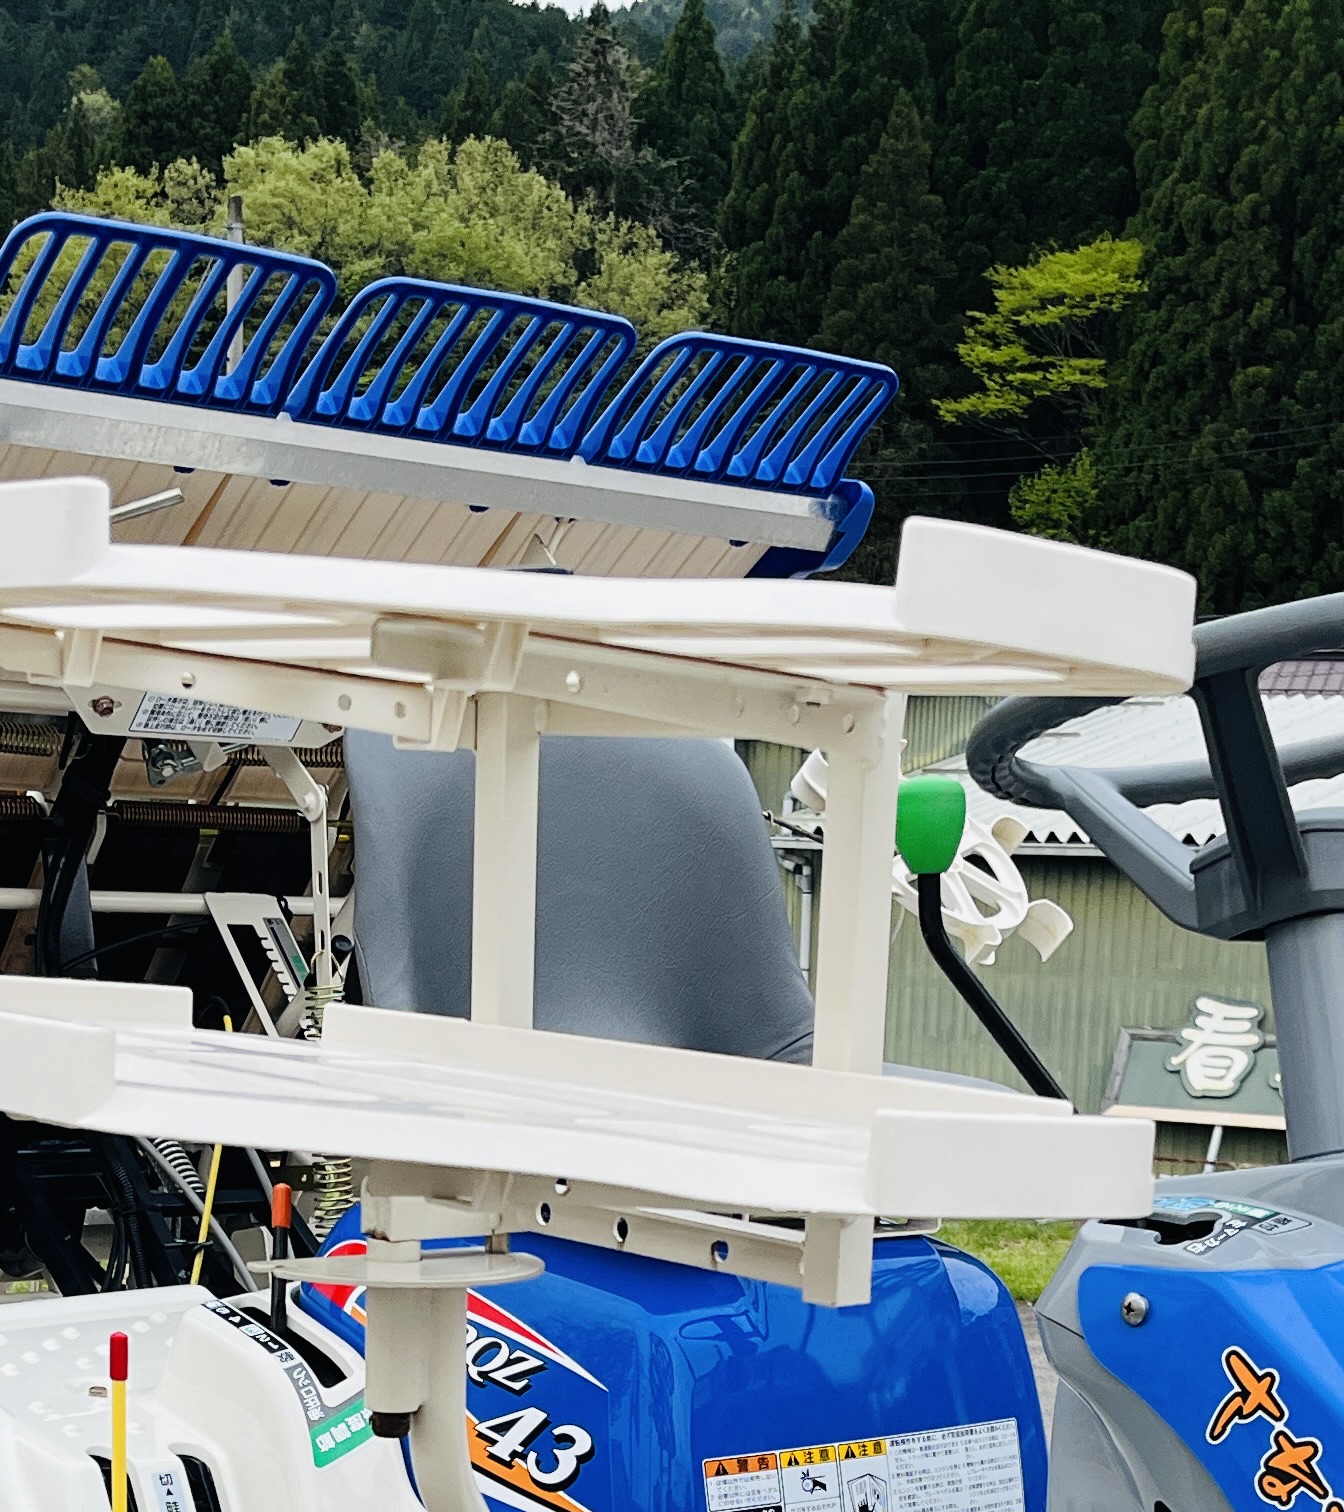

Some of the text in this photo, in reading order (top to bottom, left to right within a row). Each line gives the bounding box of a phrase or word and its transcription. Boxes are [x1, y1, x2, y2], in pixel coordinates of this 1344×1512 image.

[475, 1407, 594, 1489] 43
[802, 1448, 830, 1463] 注意
[158, 1473, 174, 1487] 切
